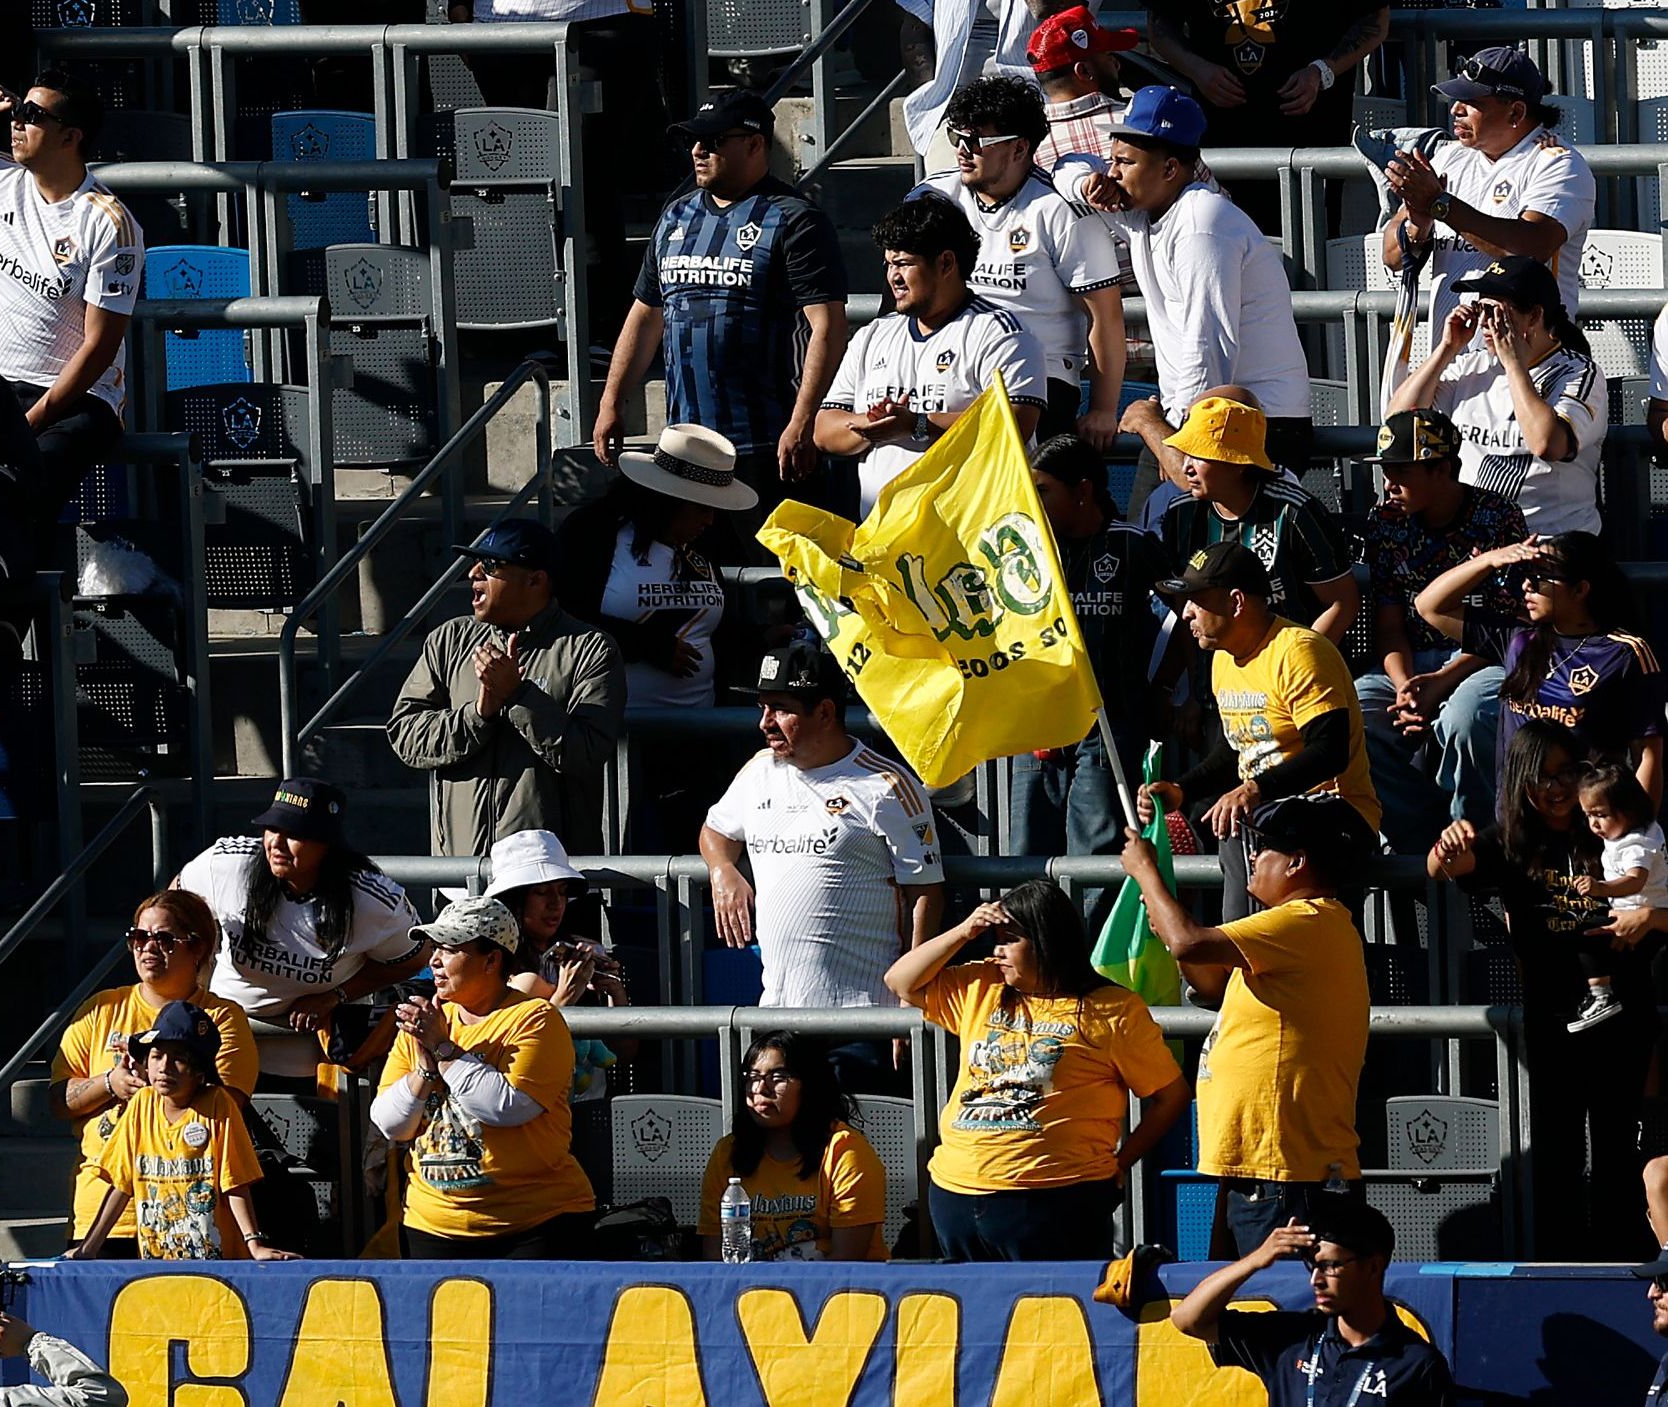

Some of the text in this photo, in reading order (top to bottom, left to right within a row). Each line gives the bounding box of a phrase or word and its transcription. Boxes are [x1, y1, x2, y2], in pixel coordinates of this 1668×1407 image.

[660, 255, 754, 274] HERBALIFE
[659, 270, 753, 287] NUTRITION
[638, 581, 722, 597] HERBALIFE
[638, 594, 723, 608] NUTRITION
[748, 830, 828, 856] Herbalife
